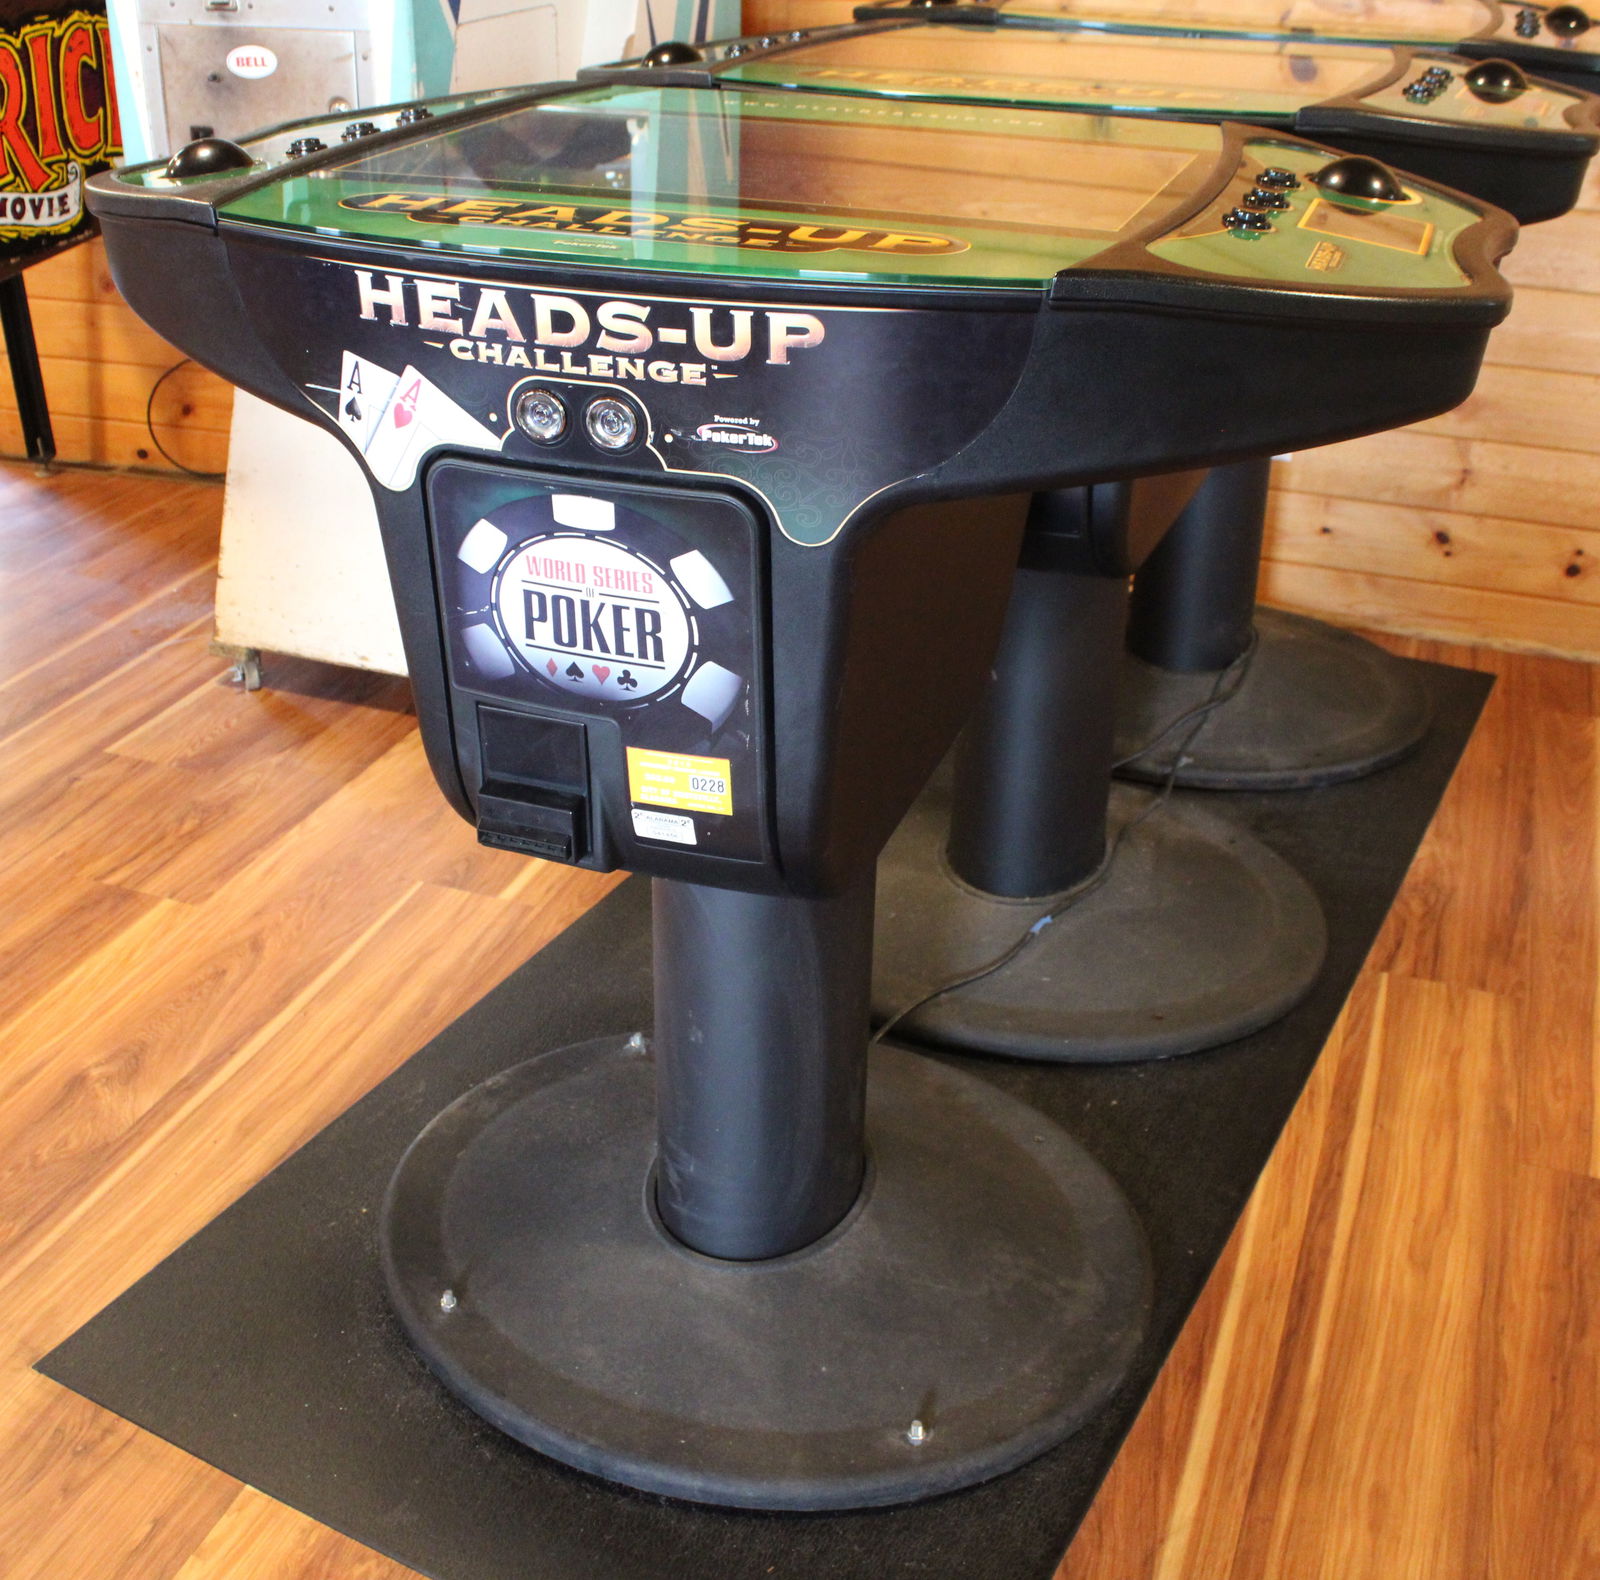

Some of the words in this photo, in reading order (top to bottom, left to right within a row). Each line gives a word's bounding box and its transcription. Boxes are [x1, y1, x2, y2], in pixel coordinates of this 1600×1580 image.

[236, 56, 269, 67] BELL
[360, 194, 951, 249] HEADS-UP
[458, 216, 779, 246] CHALLENGE
[354, 269, 826, 365] HEADS-UP
[449, 338, 708, 386] CHALLENGE
[701, 429, 773, 446] PokerTek
[714, 415, 748, 424] Powered
[749, 418, 760, 426] by
[526, 555, 586, 584] WORLD
[593, 566, 653, 594] SERIES
[523, 589, 665, 663] POKER
[691, 777, 725, 793] 0228
